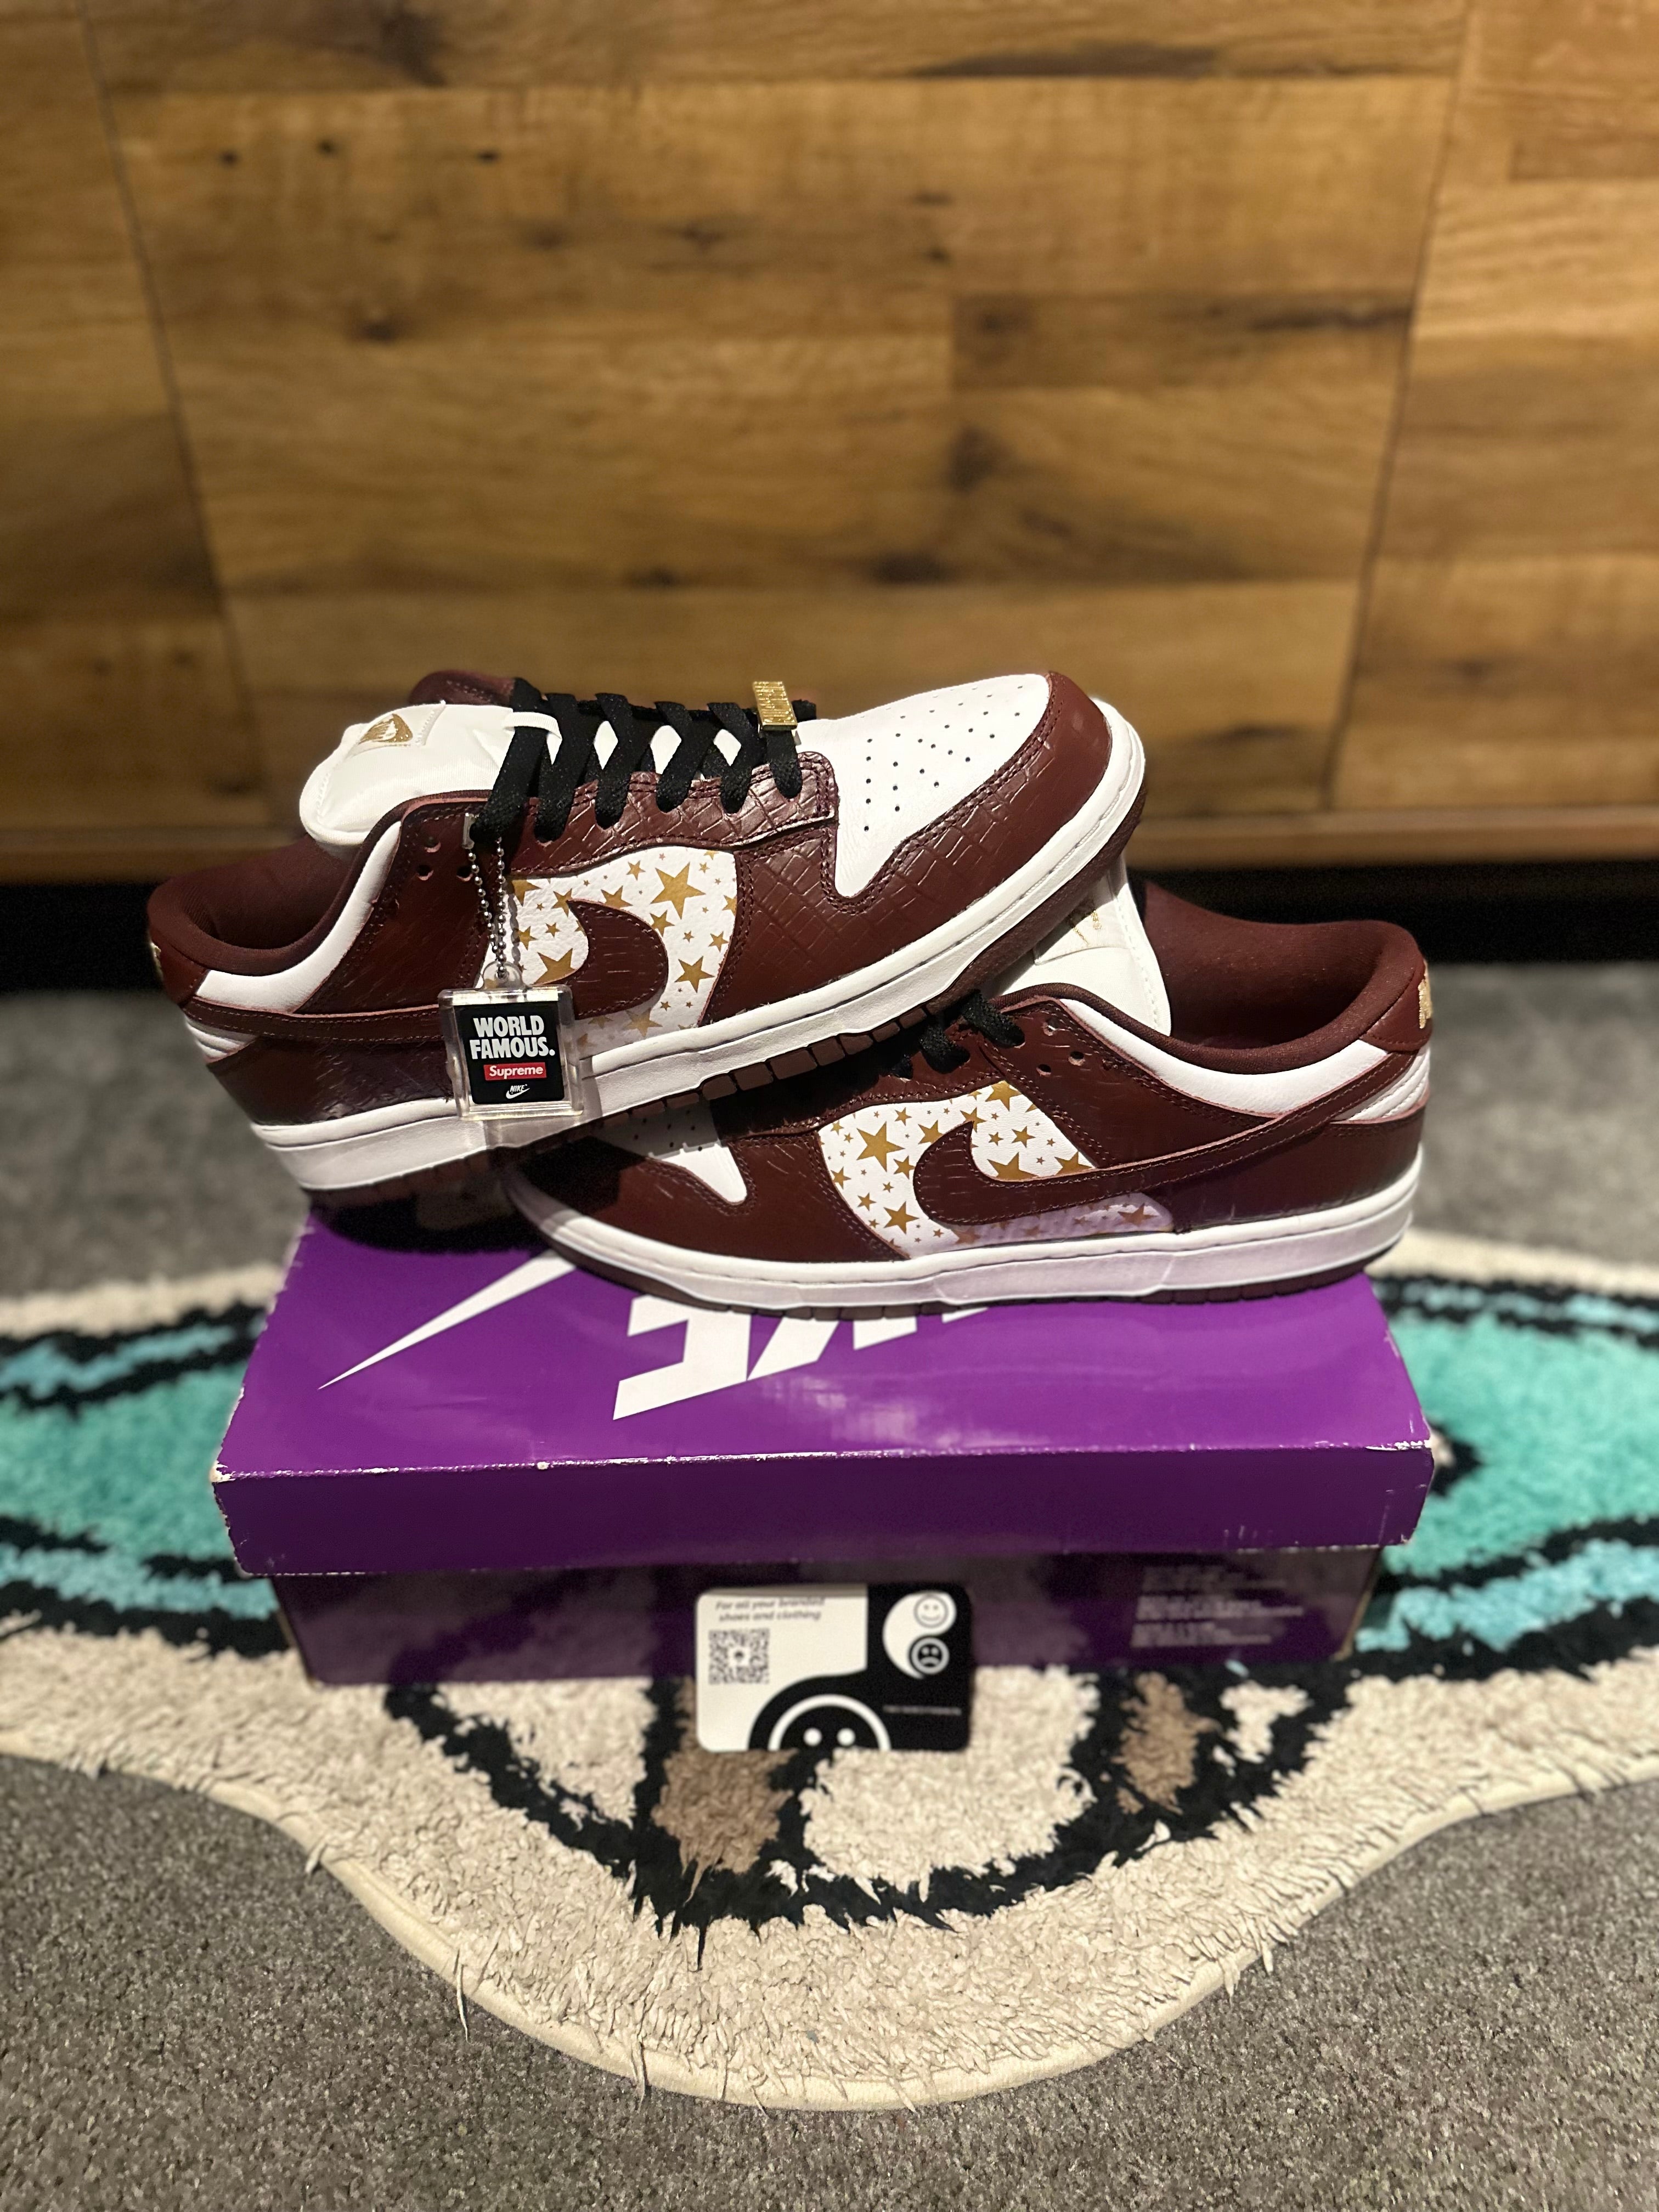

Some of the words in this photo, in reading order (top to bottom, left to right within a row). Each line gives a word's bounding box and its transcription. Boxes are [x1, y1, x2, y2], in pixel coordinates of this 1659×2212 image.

[473, 1015, 544, 1037] WORLD
[470, 1036, 555, 1059] FAMOUS.
[489, 1065, 544, 1080] Supreme
[715, 1601, 732, 1610] For
[735, 1600, 751, 1609] all
[752, 1600, 776, 1610] your
[719, 1613, 750, 1622] shoes
[753, 1611, 775, 1621] and
[777, 1611, 822, 1622] clothing
